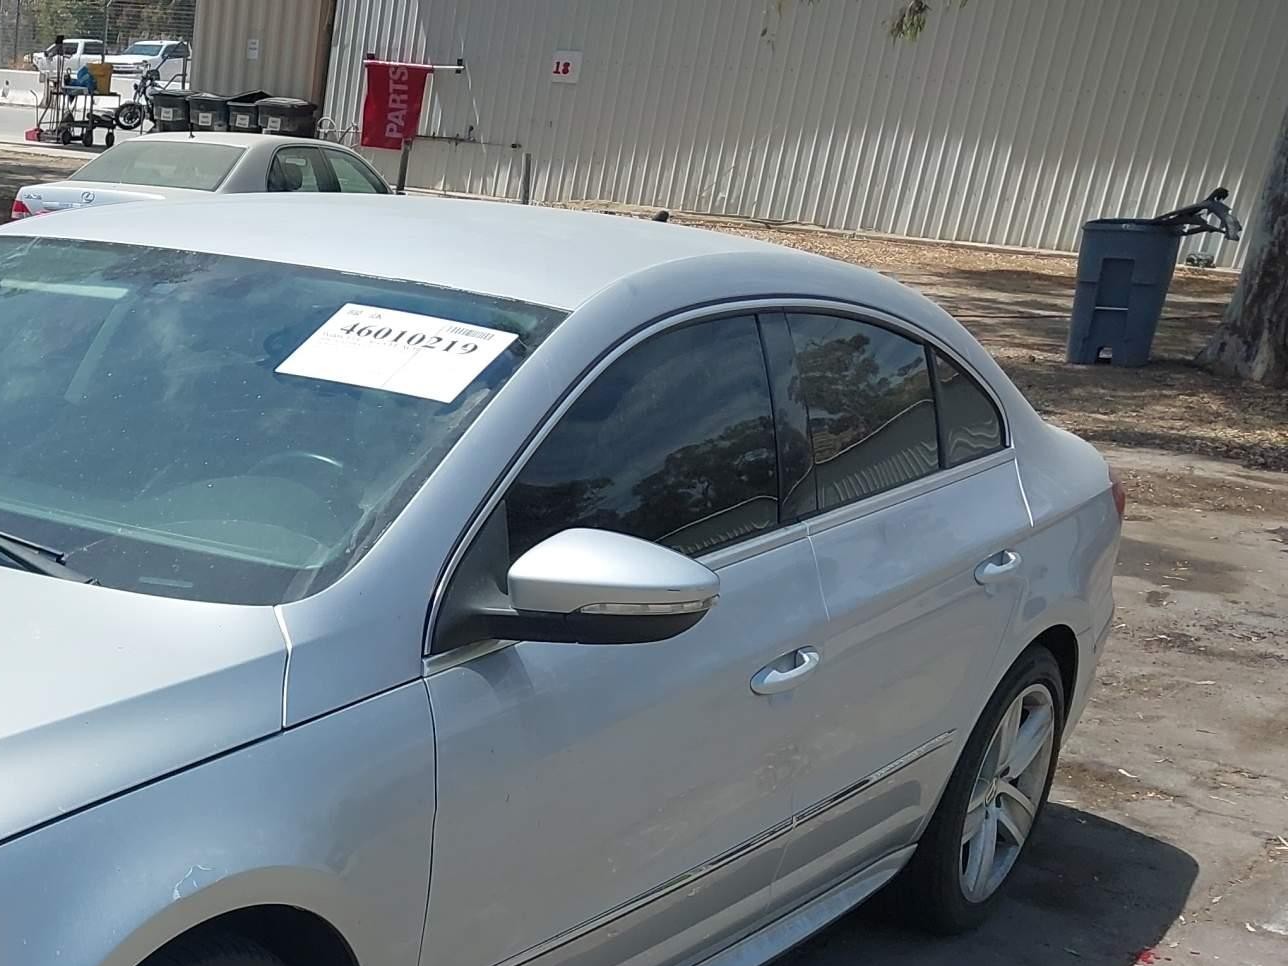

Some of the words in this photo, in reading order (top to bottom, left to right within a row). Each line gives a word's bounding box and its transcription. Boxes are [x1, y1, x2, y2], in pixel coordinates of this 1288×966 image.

[552, 61, 570, 75] 18
[385, 65, 409, 138] PARTS
[340, 322, 479, 355] 46010219
